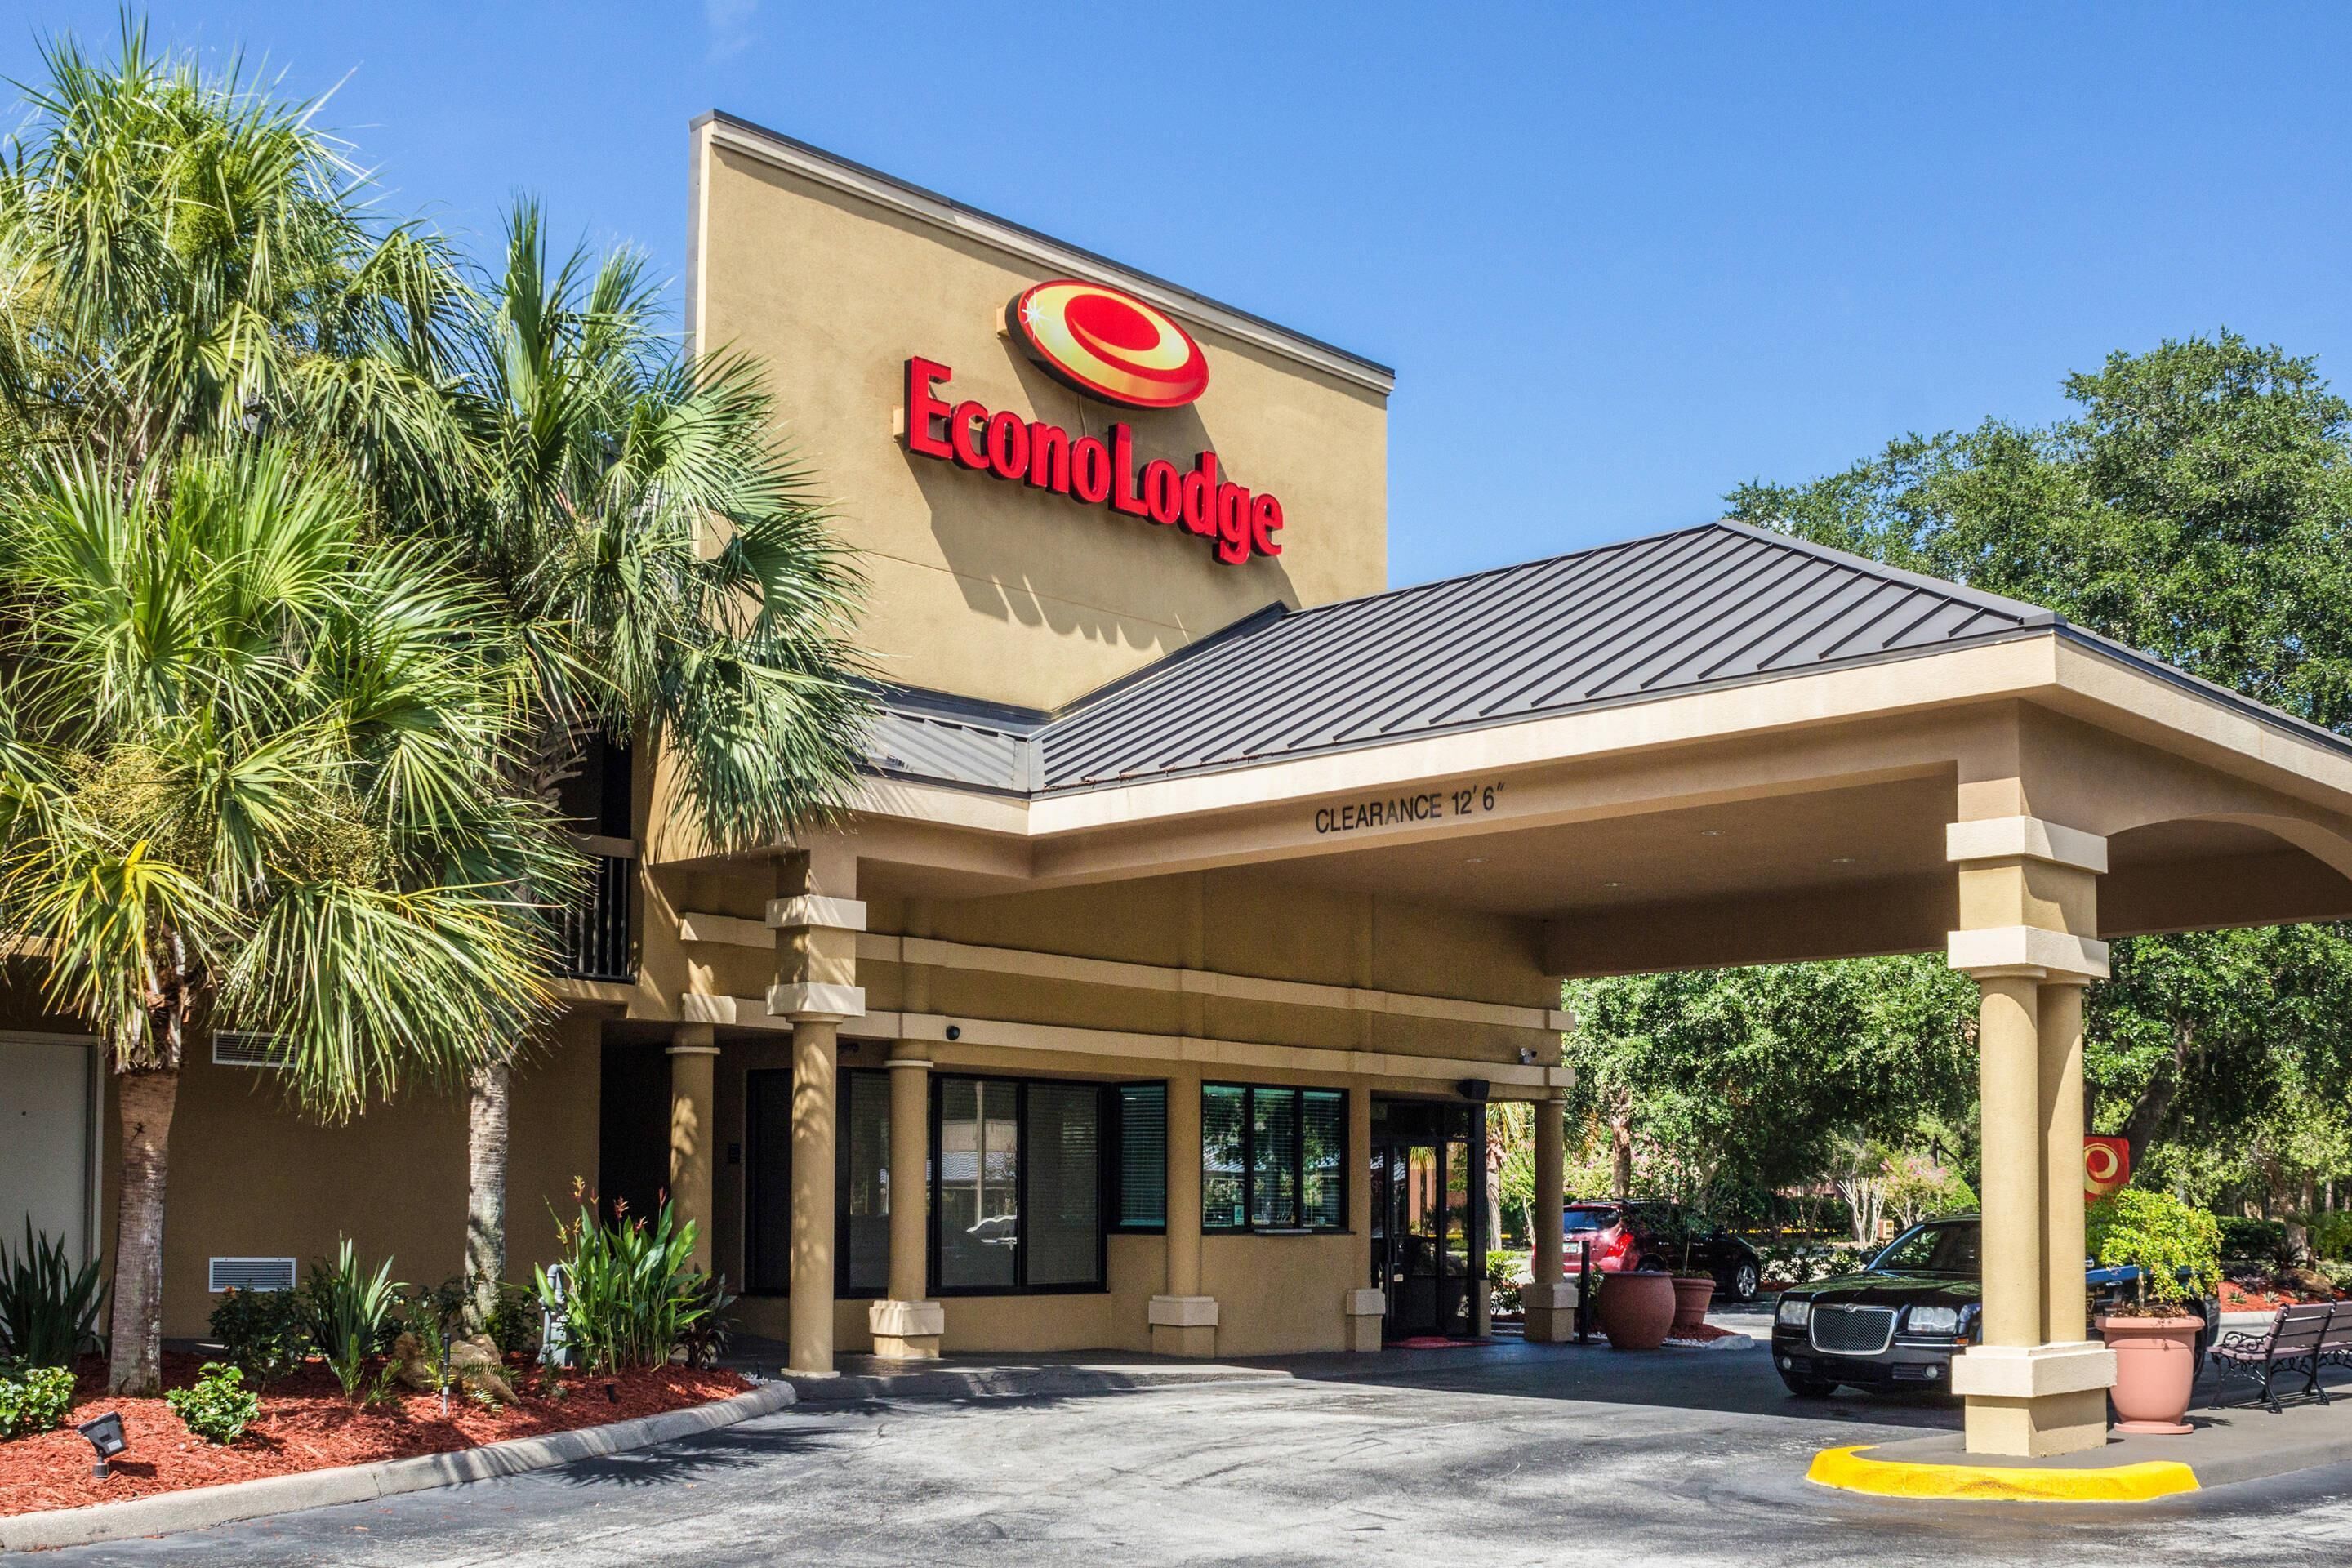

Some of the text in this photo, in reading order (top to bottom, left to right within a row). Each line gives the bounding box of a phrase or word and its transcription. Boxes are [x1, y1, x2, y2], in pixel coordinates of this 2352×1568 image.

[904, 355, 1284, 565] EconoLodge
[1315, 782, 1505, 834] CLEARANCE 12' 6"
